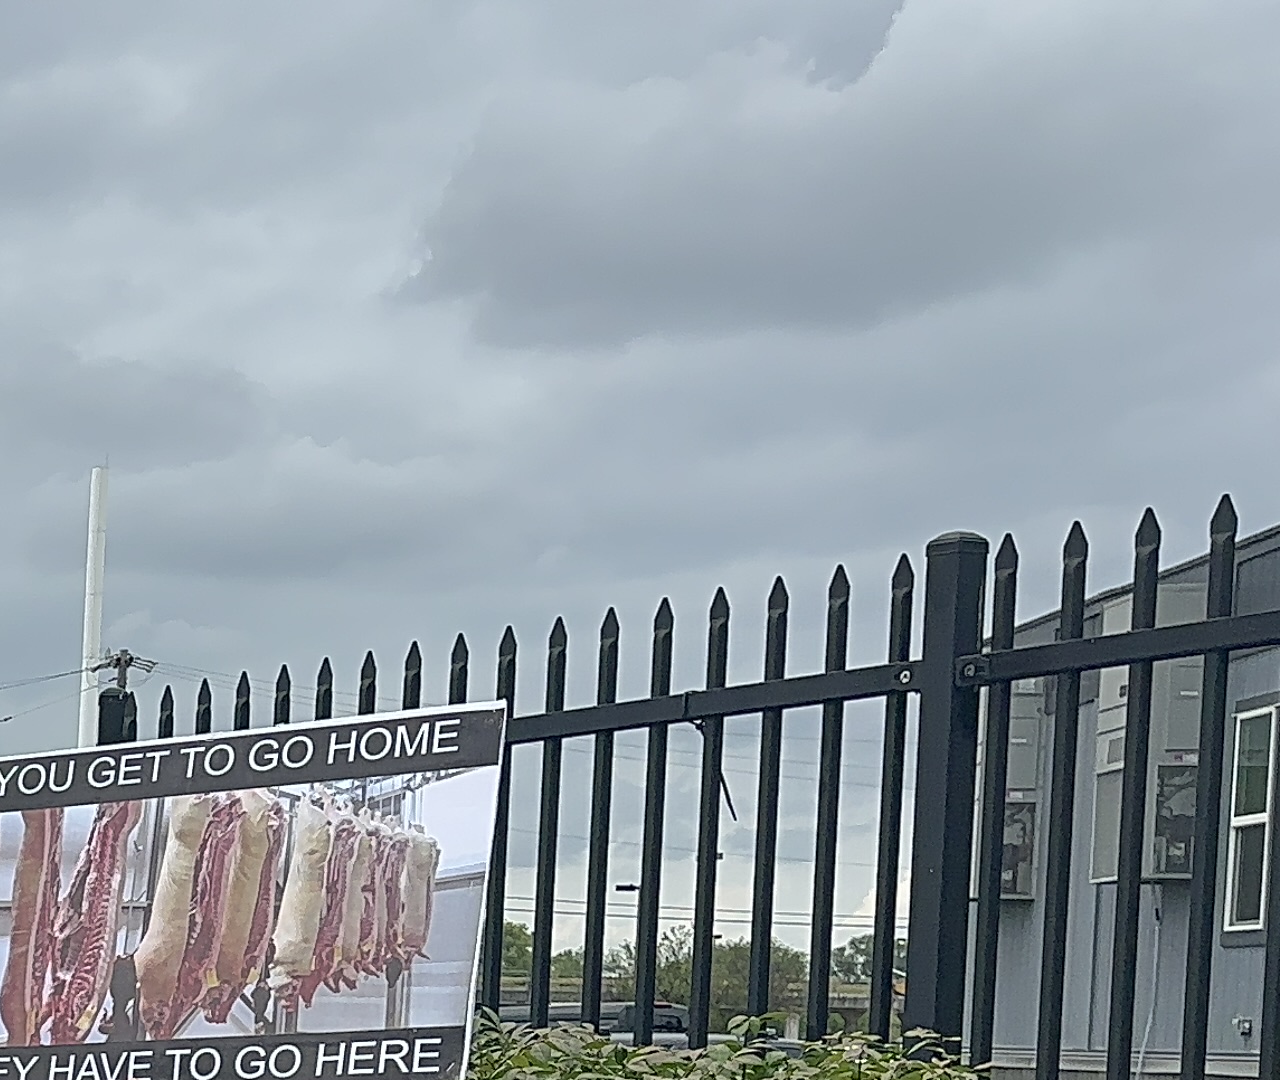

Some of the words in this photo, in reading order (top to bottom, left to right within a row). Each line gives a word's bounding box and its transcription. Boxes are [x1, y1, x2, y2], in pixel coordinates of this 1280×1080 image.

[88, 750, 171, 788] GET
[181, 743, 235, 778] TO
[249, 735, 314, 771] GO
[328, 718, 461, 764] HOME
[235, 1044, 301, 1080] GO
[315, 1038, 442, 1077] HERE
